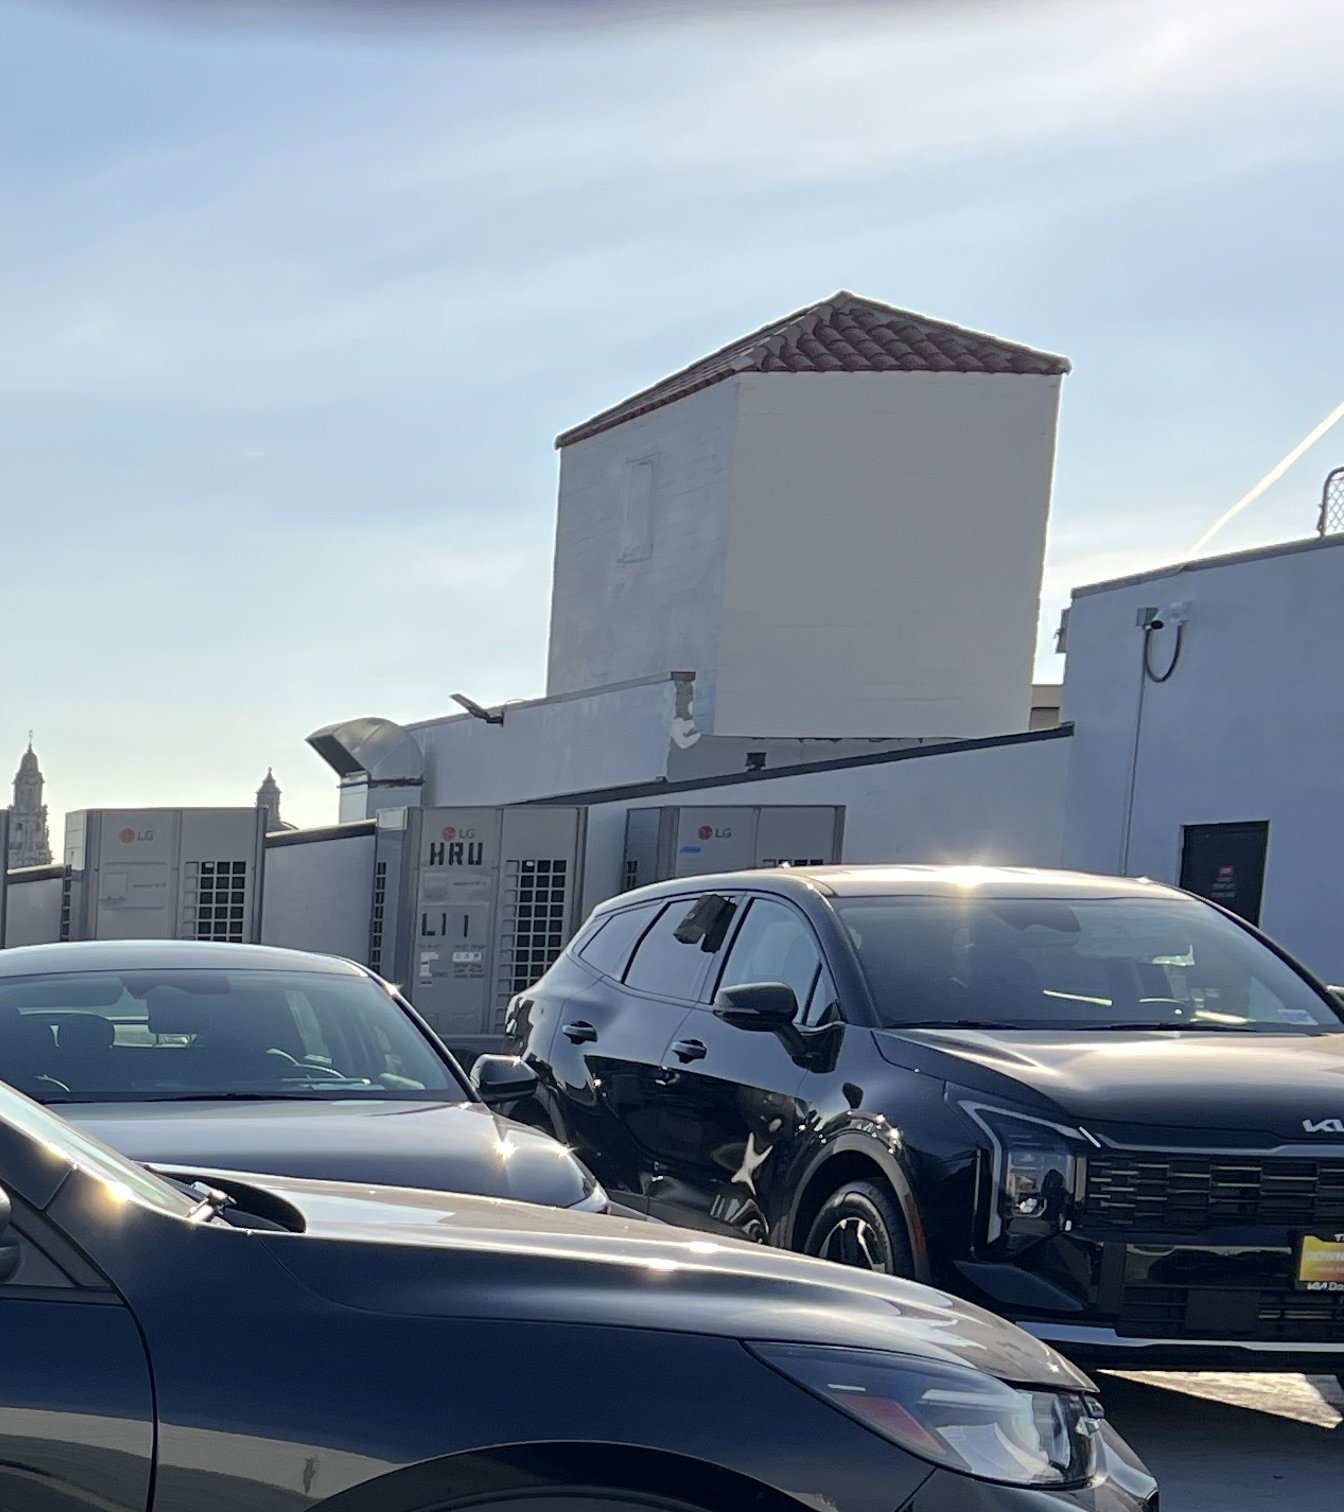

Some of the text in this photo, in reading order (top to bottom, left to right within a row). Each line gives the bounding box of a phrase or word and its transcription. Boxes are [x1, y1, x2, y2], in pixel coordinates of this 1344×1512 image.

[137, 830, 154, 842] LG
[459, 828, 476, 839] LG
[714, 827, 732, 839] LG
[429, 842, 483, 866] HRU
